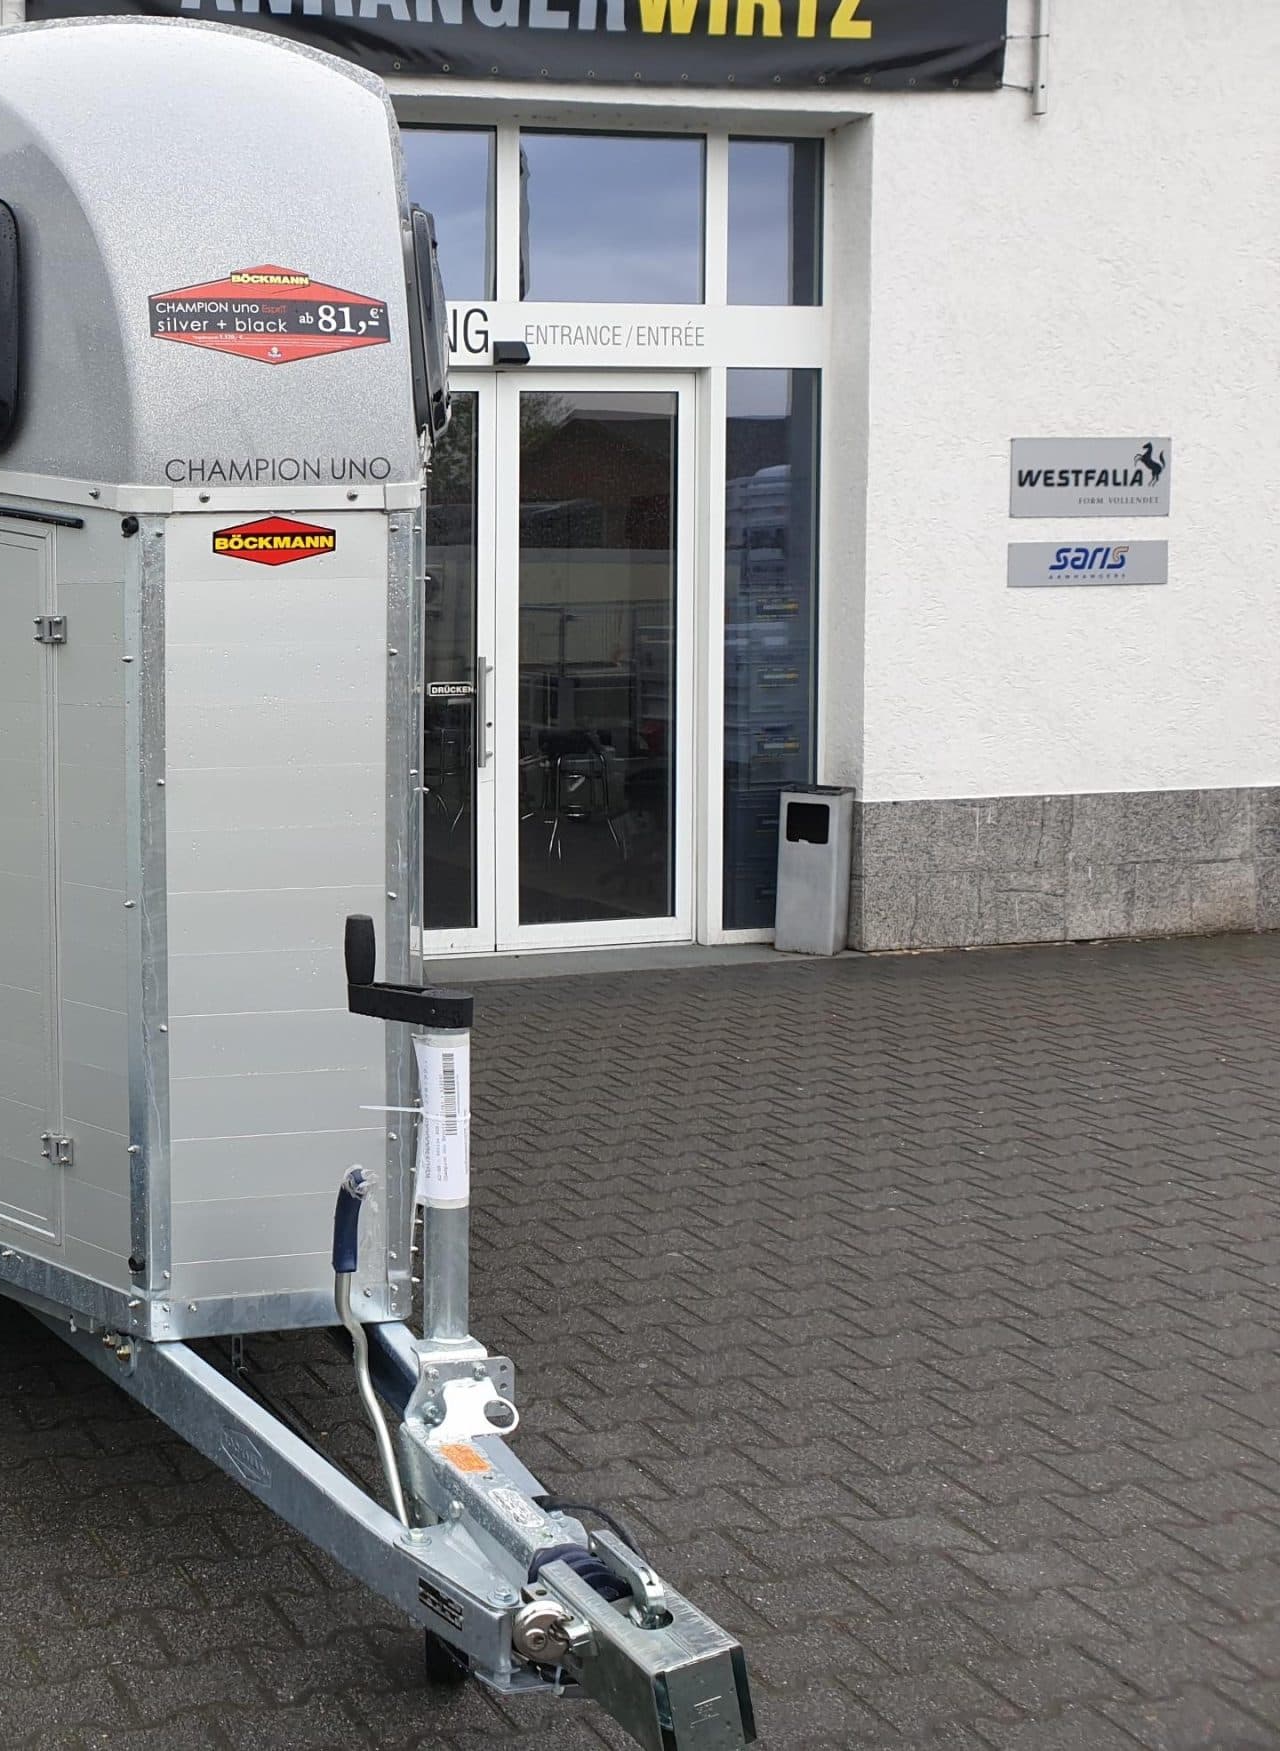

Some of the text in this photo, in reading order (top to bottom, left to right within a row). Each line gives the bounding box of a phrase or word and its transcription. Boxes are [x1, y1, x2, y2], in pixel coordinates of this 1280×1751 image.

[231, 273, 309, 285] BÖCKMANN
[155, 302, 229, 313] CHAMPION
[232, 303, 260, 313] uno
[157, 317, 208, 332] silver
[235, 319, 288, 333] black
[299, 312, 314, 324] ab
[524, 323, 622, 346] ENTRANCE
[635, 321, 705, 347] ENTRÉE
[165, 457, 391, 482] CHAMPION UNO
[1018, 469, 1143, 487] WESTFALIA
[215, 534, 334, 550] BÖCKMANN
[1048, 545, 1129, 570] saris
[431, 685, 474, 694] DRÜCKEN
